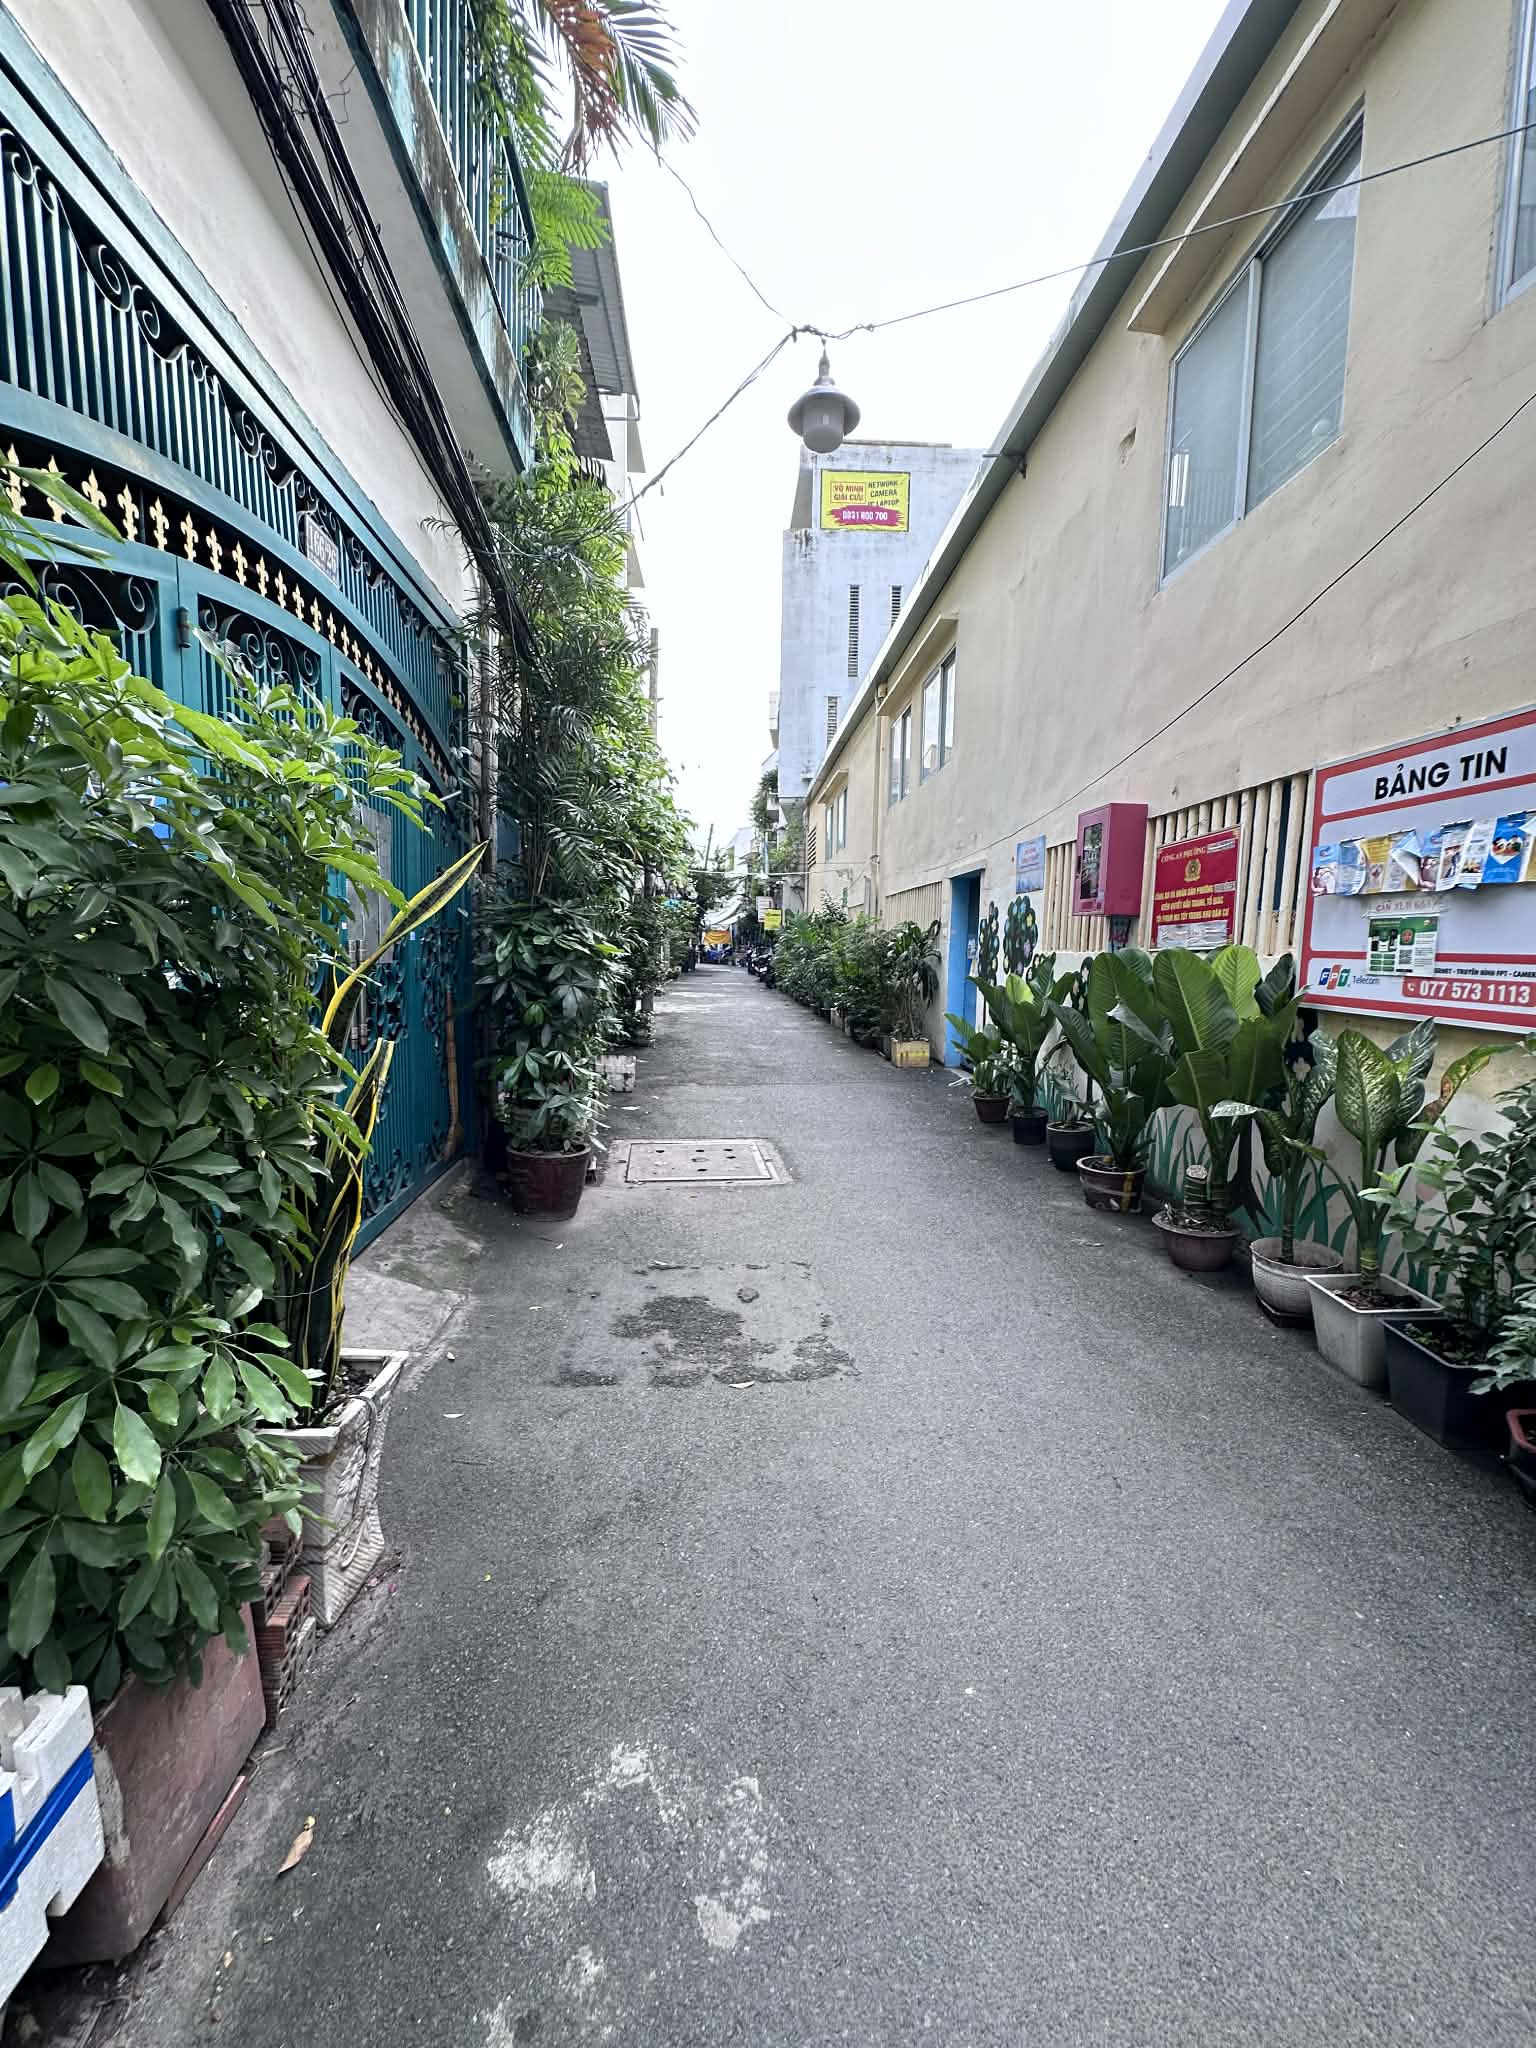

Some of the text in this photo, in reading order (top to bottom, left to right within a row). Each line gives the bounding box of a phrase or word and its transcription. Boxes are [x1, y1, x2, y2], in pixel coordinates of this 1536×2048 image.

[868, 480, 898, 489] NETWORK
[870, 489, 898, 498] CAMERA
[875, 511, 888, 521] 700
[1375, 747, 1508, 801] BẢNG TIN
[1318, 964, 1380, 990] FPT Telecom
[1419, 980, 1531, 1004] 077 573 1113
